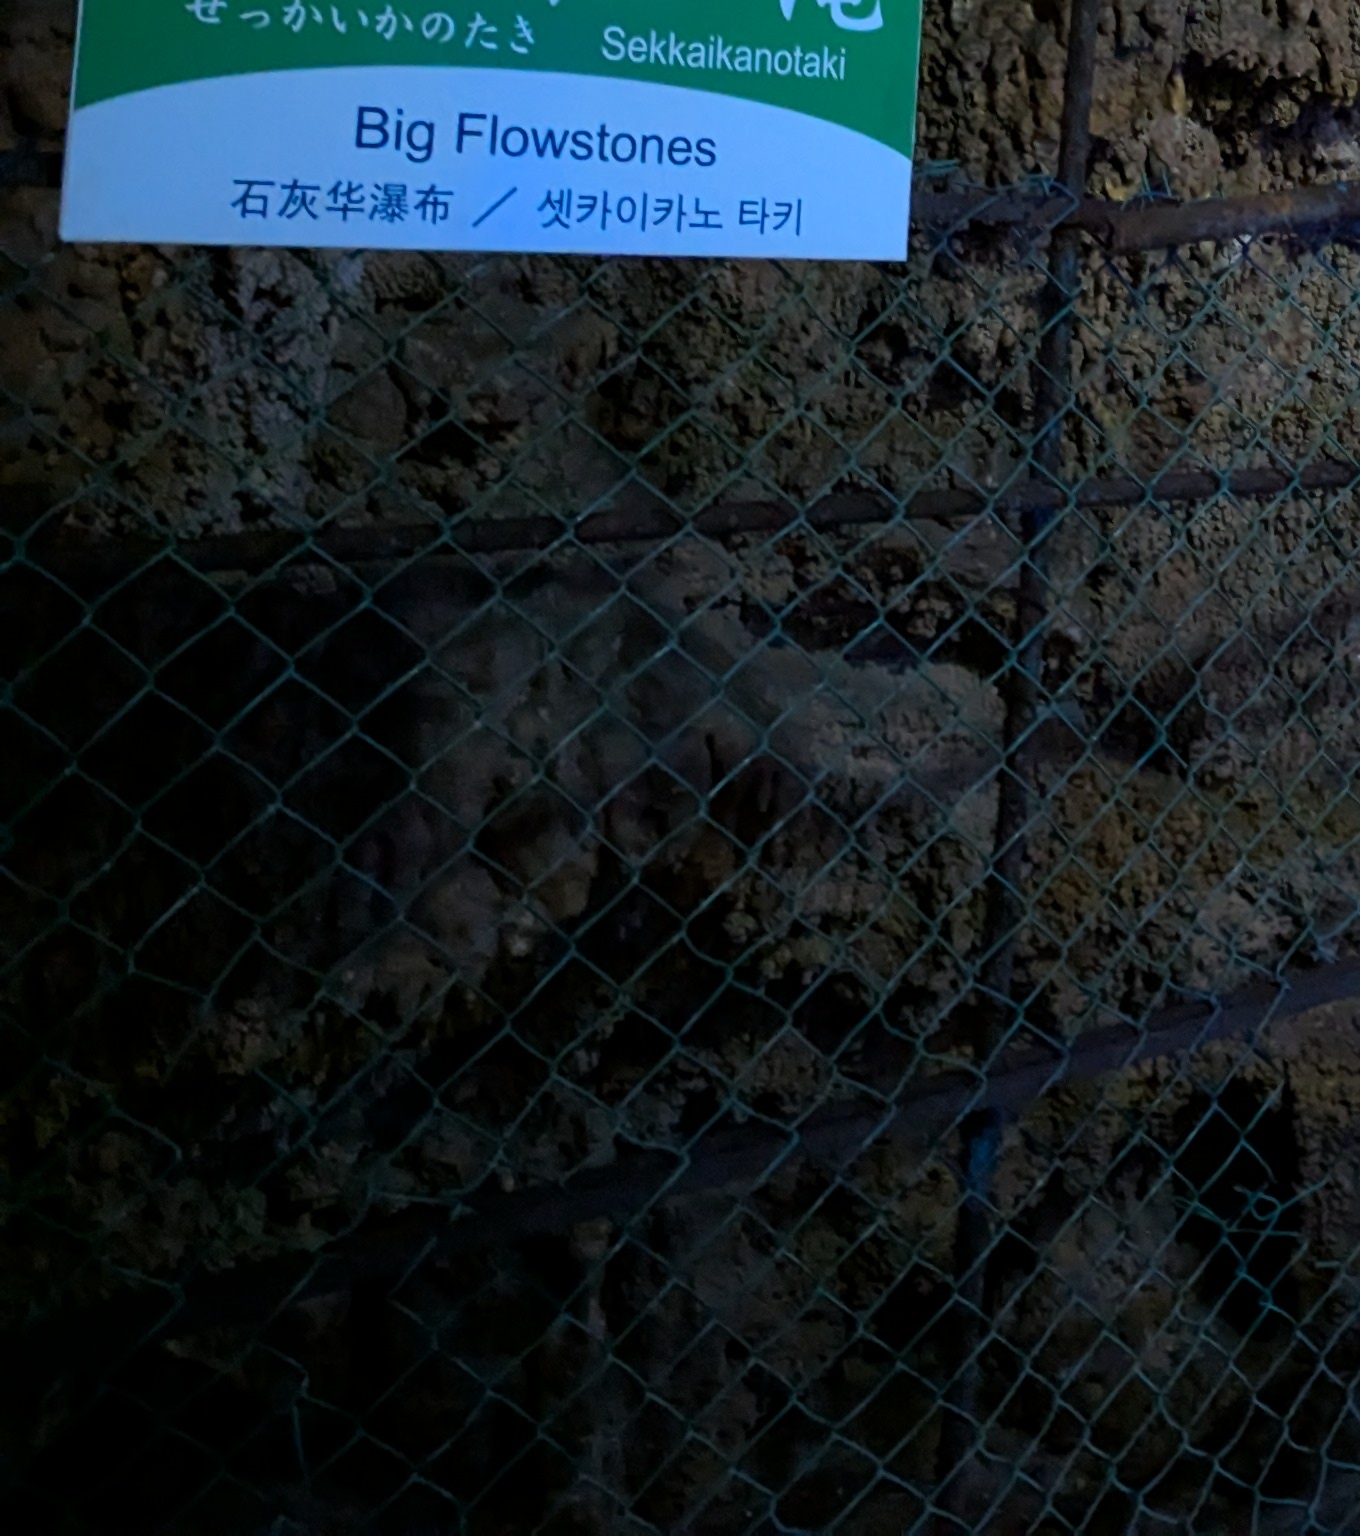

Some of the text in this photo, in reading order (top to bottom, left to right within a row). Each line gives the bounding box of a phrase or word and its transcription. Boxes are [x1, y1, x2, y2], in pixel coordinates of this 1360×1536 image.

[602, 26, 847, 80] Sekkaikanotaki
[355, 107, 716, 167] Big Flowstones
[230, 180, 454, 222] 石灰华瀑布
[538, 188, 723, 233] 셋카이카노
[739, 197, 803, 235] 타키
